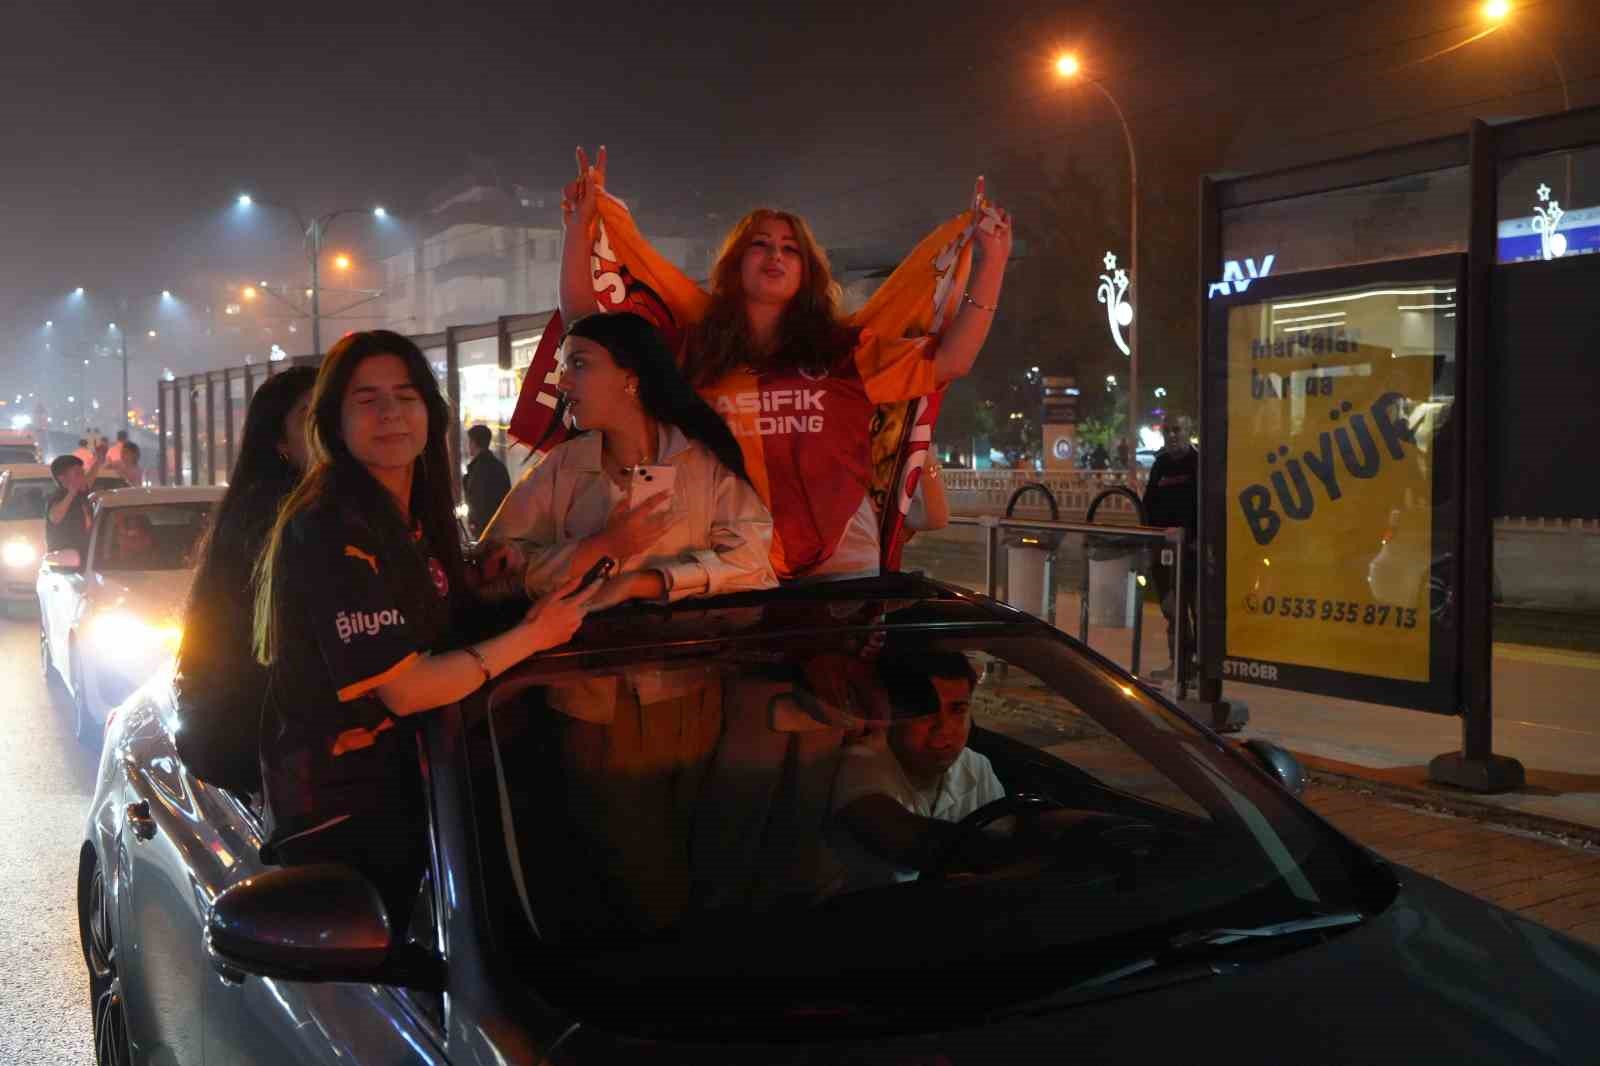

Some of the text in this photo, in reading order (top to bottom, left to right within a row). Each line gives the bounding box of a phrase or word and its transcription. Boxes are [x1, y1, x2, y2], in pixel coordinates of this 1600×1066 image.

[1263, 596, 1417, 629] 0 533 935 87 13
